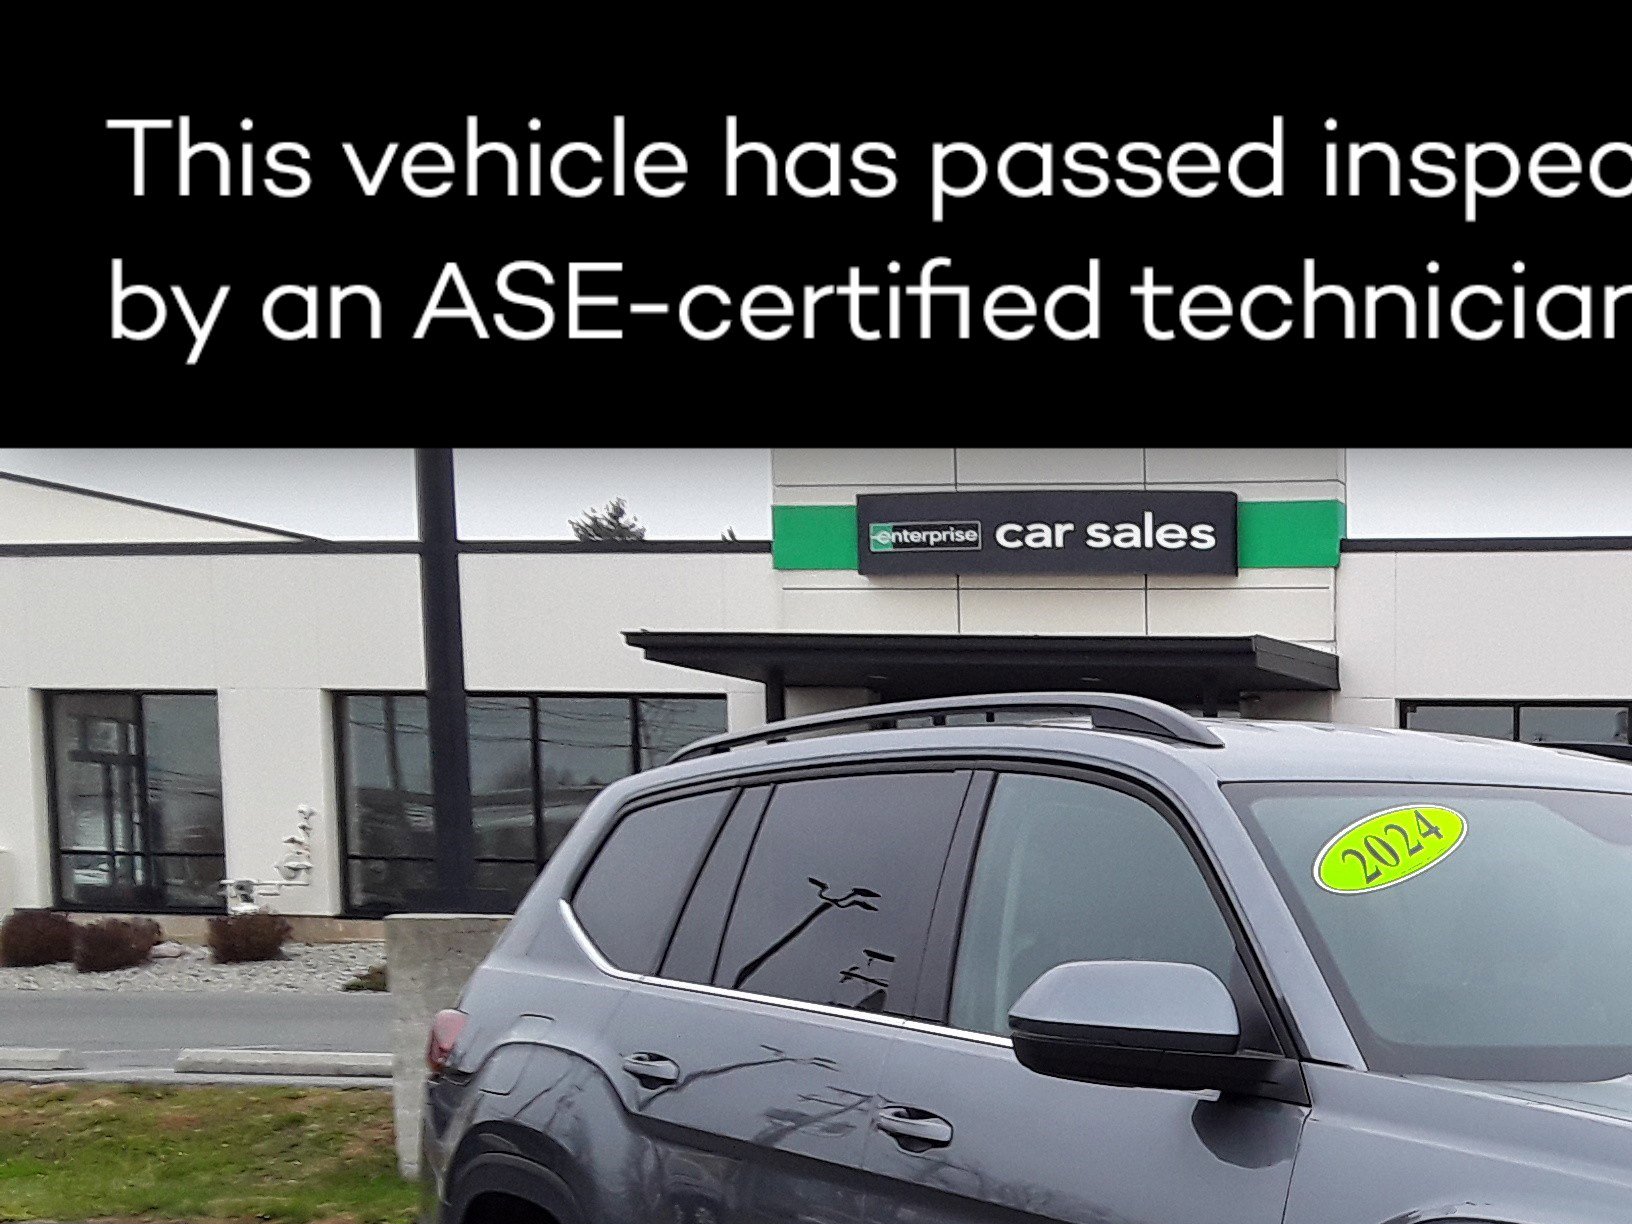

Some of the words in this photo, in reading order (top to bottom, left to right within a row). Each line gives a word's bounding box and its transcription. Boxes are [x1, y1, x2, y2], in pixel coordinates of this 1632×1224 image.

[878, 527, 979, 547] enterprise
[996, 523, 1075, 549] car
[1086, 511, 1216, 549] sales
[1341, 809, 1443, 884] 2024
